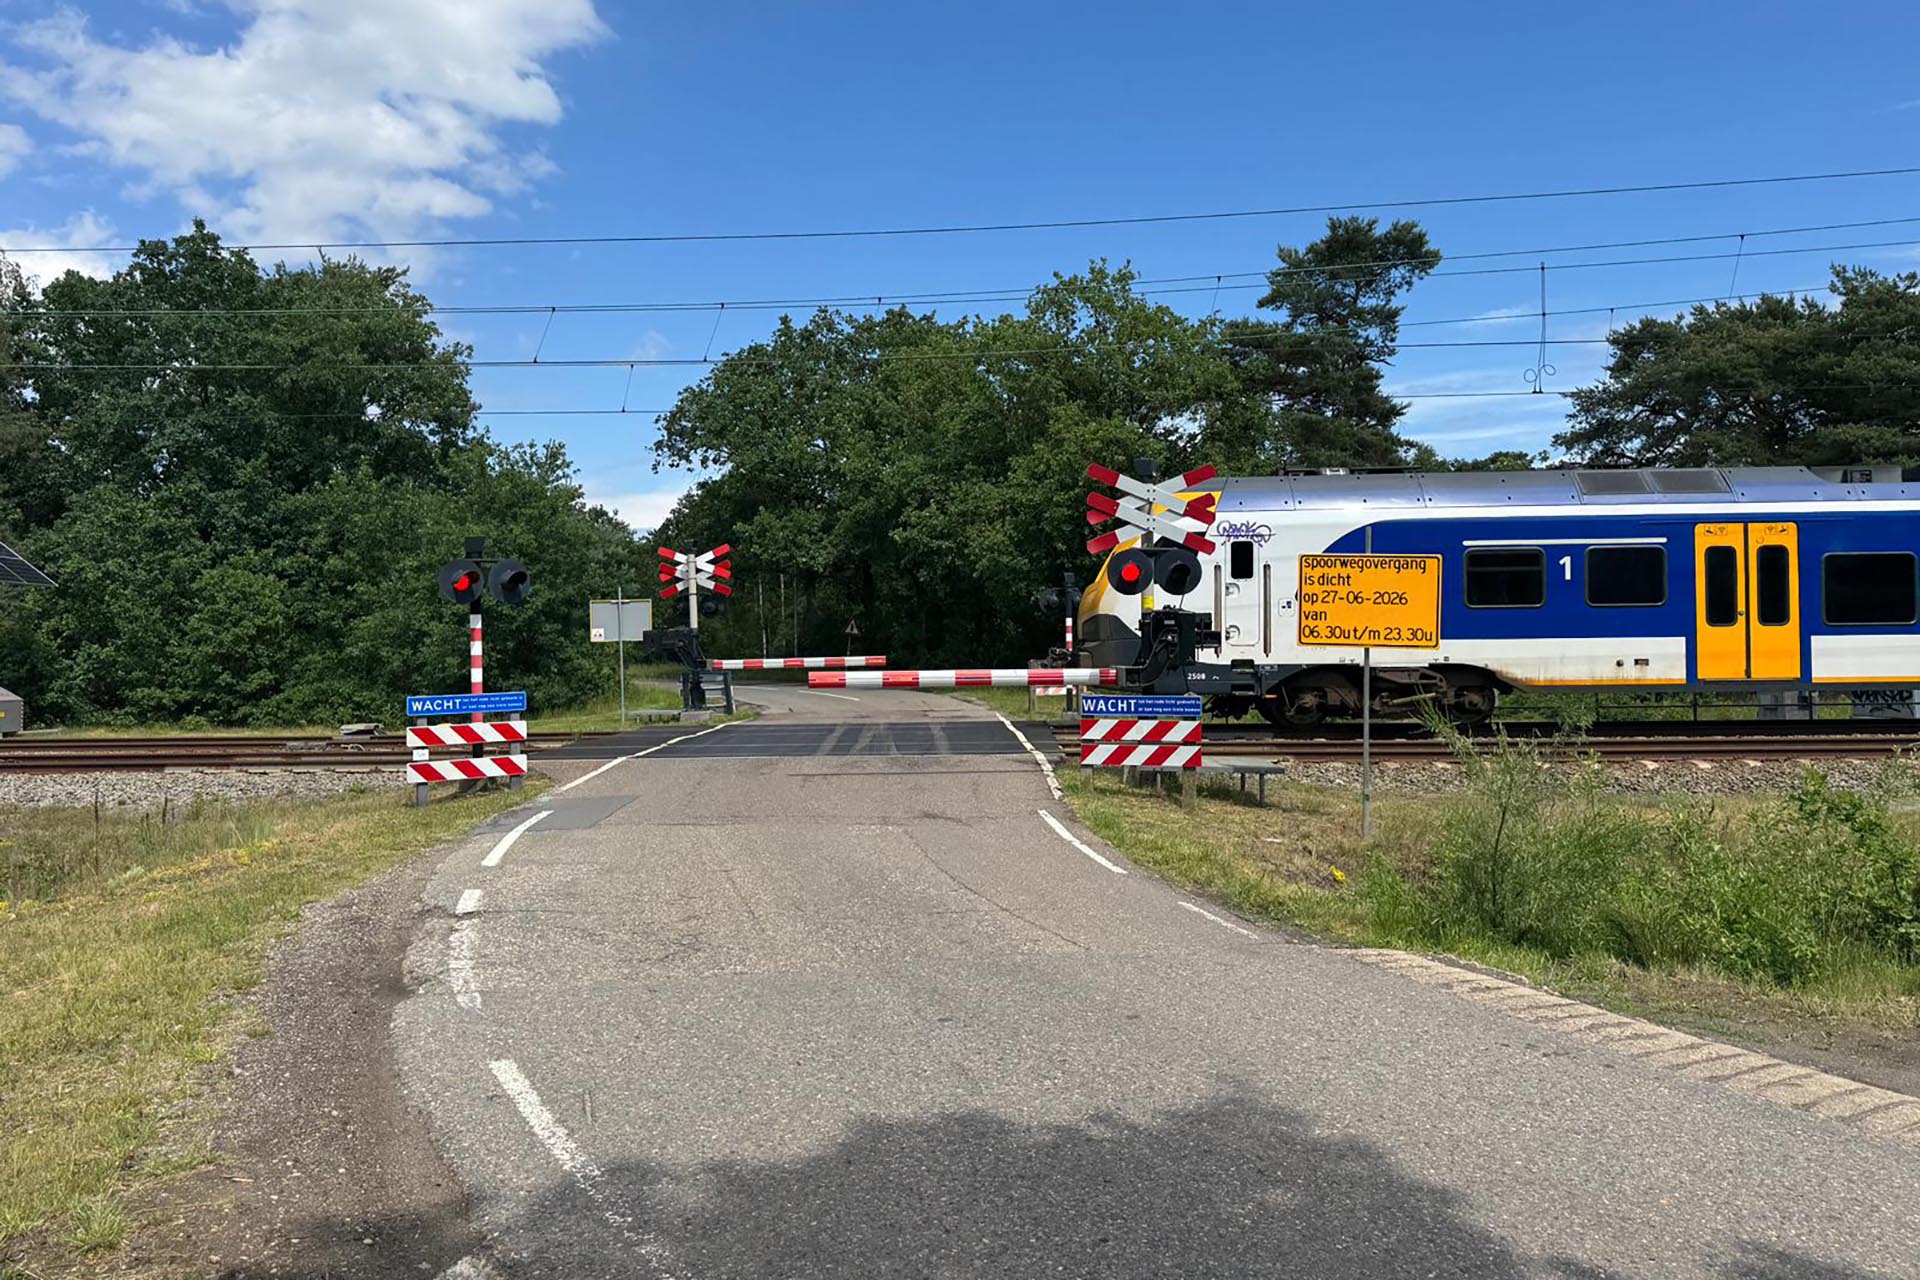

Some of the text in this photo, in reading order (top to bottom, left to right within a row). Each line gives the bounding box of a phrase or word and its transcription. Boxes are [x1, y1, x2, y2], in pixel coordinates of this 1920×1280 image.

[1303, 557, 1427, 575] spoorwegovergang
[1558, 555, 1571, 580] 1
[1304, 573, 1352, 586] is dicht
[1303, 590, 1409, 605] op 27-06-2026
[1303, 610, 1328, 621] van
[1353, 626, 1381, 640] t/m
[1383, 627, 1433, 641] 23.30u
[411, 699, 462, 712] WACHT
[1082, 699, 1137, 712] WACHT
